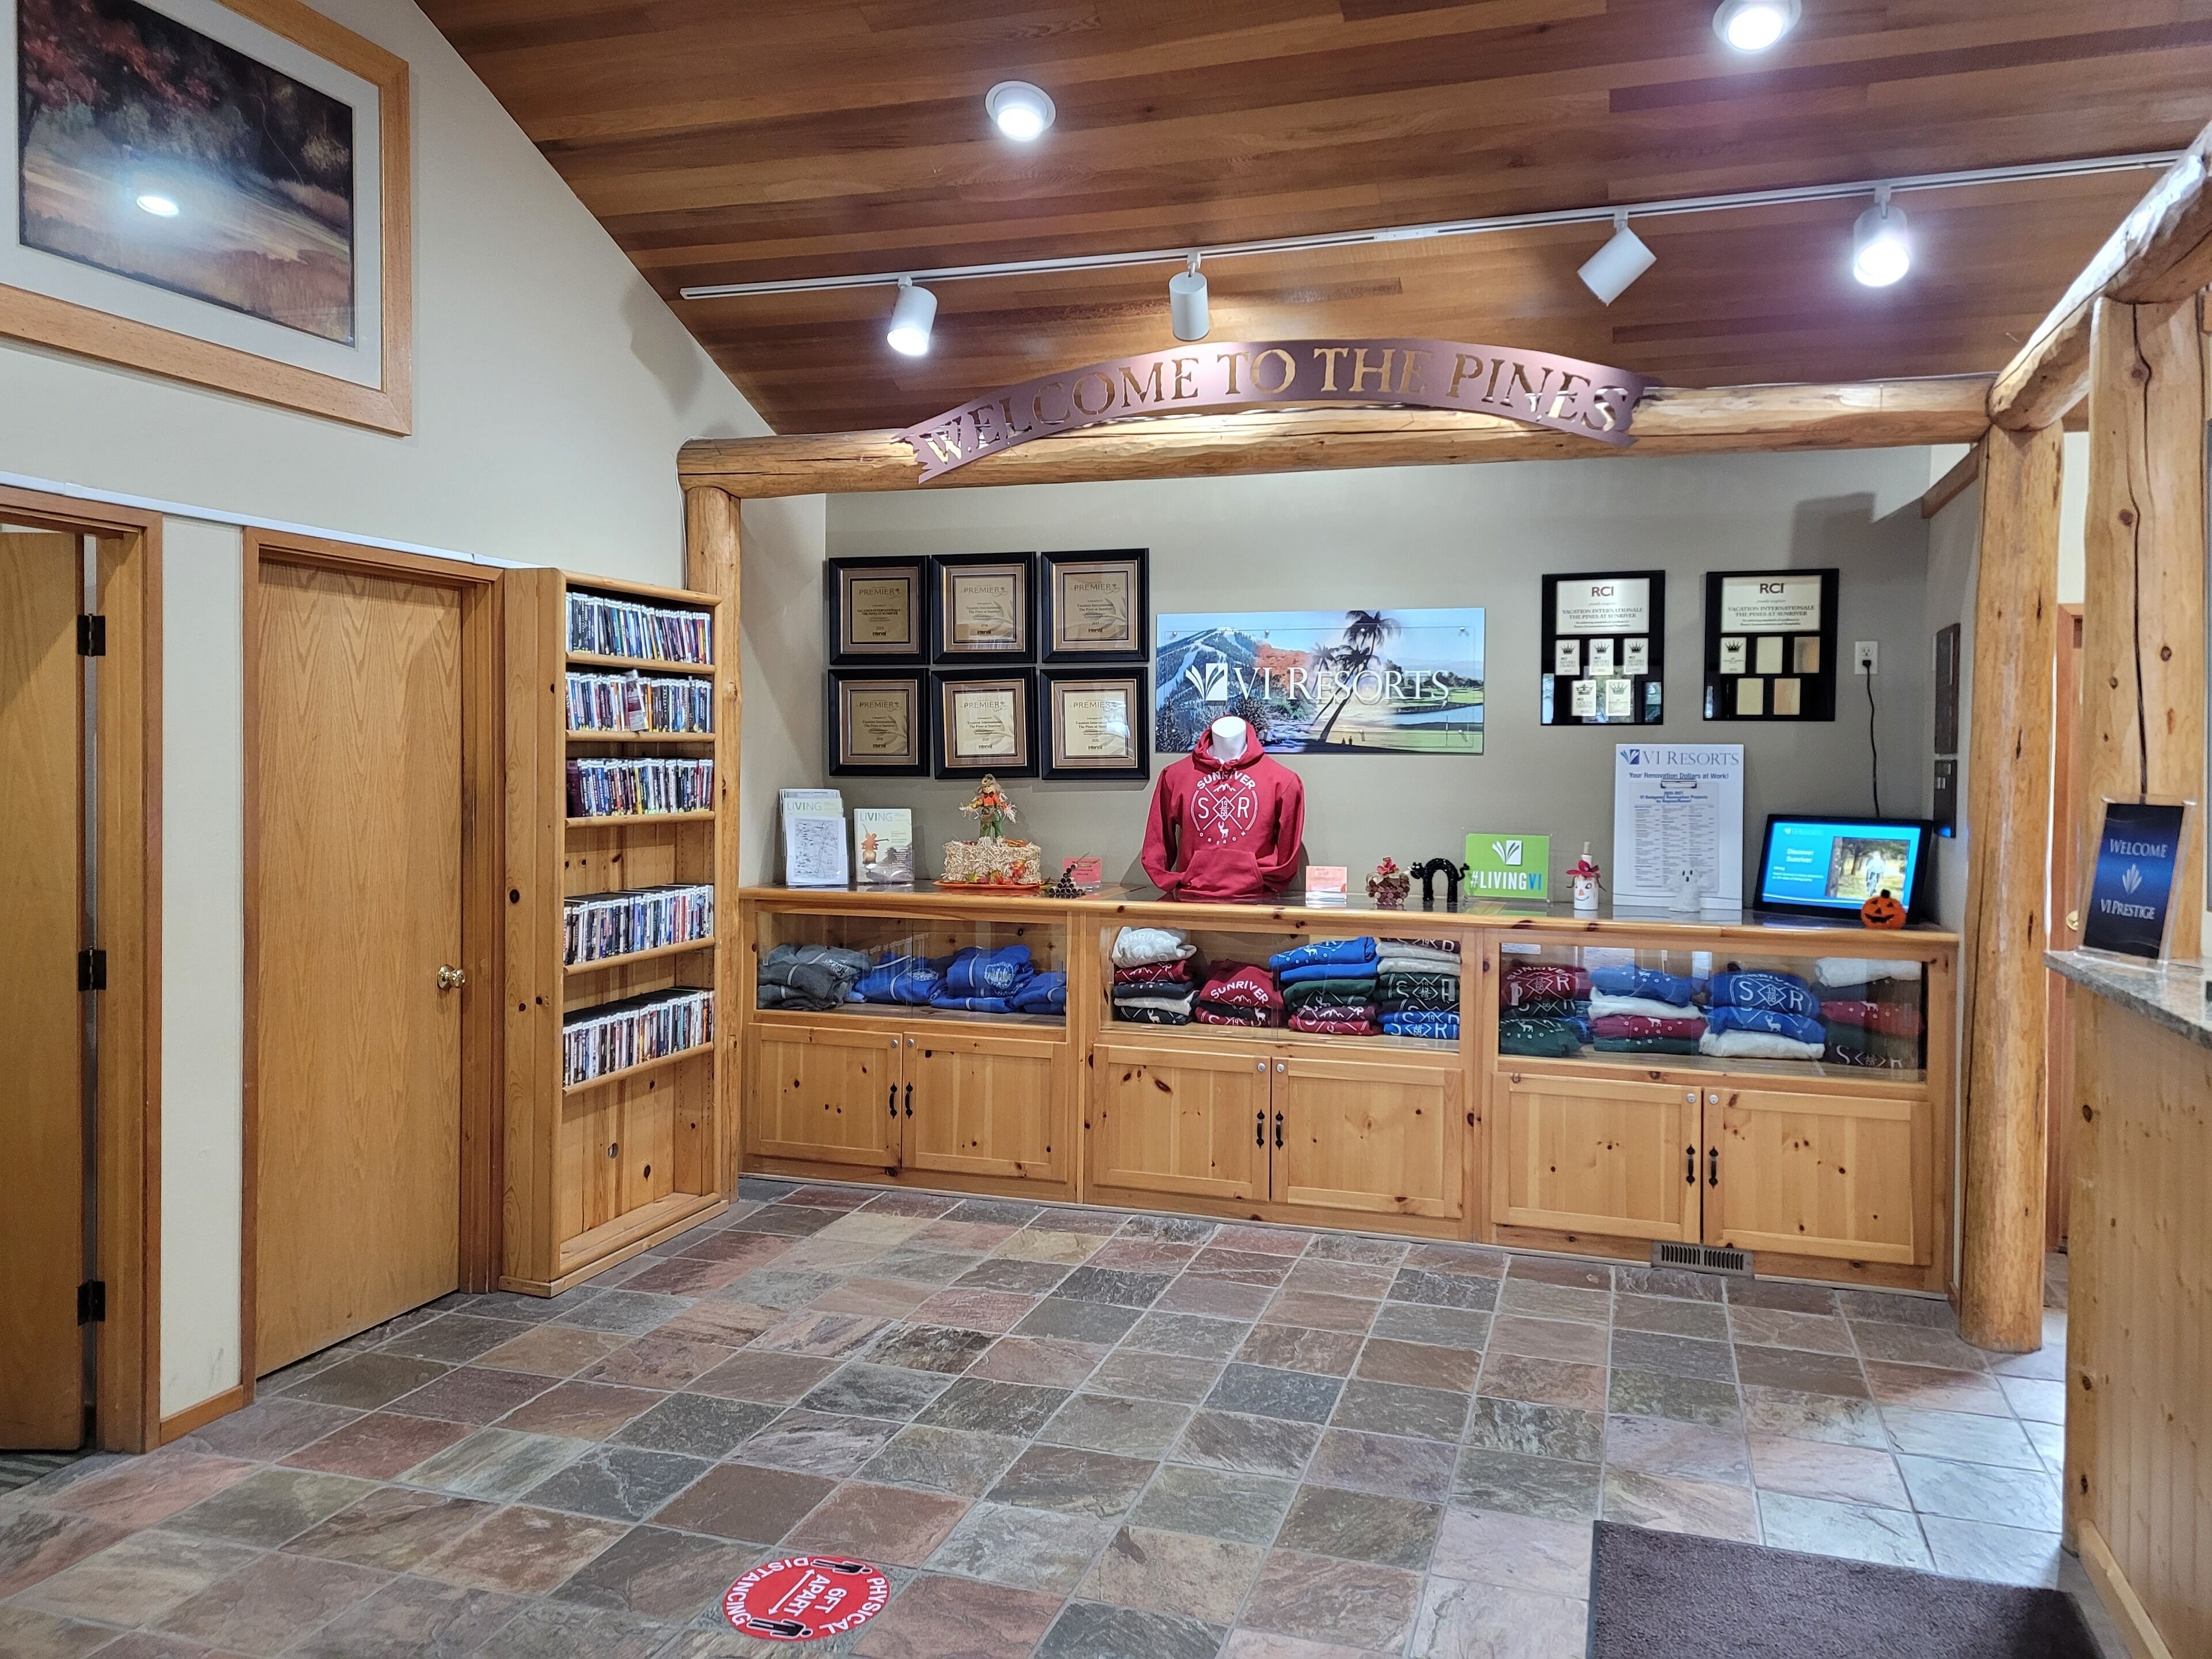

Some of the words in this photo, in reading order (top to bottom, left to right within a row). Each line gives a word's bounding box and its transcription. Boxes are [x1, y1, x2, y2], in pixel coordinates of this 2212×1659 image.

[921, 358, 1198, 465] WELCOME
[1217, 349, 1296, 395] TO
[1314, 347, 1433, 394] THE
[1449, 353, 1630, 432] PINES
[1592, 586, 1614, 597] RCI
[1759, 582, 1785, 594] RCI
[1232, 666, 1270, 701] VI
[1288, 666, 1449, 702] RESORTS
[1643, 751, 1660, 765] VI
[1668, 751, 1739, 766] RESORTS
[787, 801, 821, 810] LIVING
[1198, 797, 1209, 819] S
[1237, 797, 1250, 818] R
[860, 812, 893, 821] LIVING
[2110, 839, 2168, 858] WELCOME
[1470, 870, 1541, 891] #LIVINGVI
[2101, 899, 2111, 914] VI
[2112, 900, 2156, 920] PRESTIGE
[1119, 932, 1171, 945] UNRIER
[1210, 980, 1268, 1004] SUNRIVER
[1557, 976, 1570, 991] R
[1738, 981, 1754, 1001] S
[1790, 990, 1804, 1012] R
[1767, 995, 1777, 1003] 68
[726, 1557, 809, 1626] DISTANCING
[783, 1574, 831, 1616] APART
[814, 1588, 847, 1613] 6FT
[819, 1577, 888, 1634] PHYSICAL
